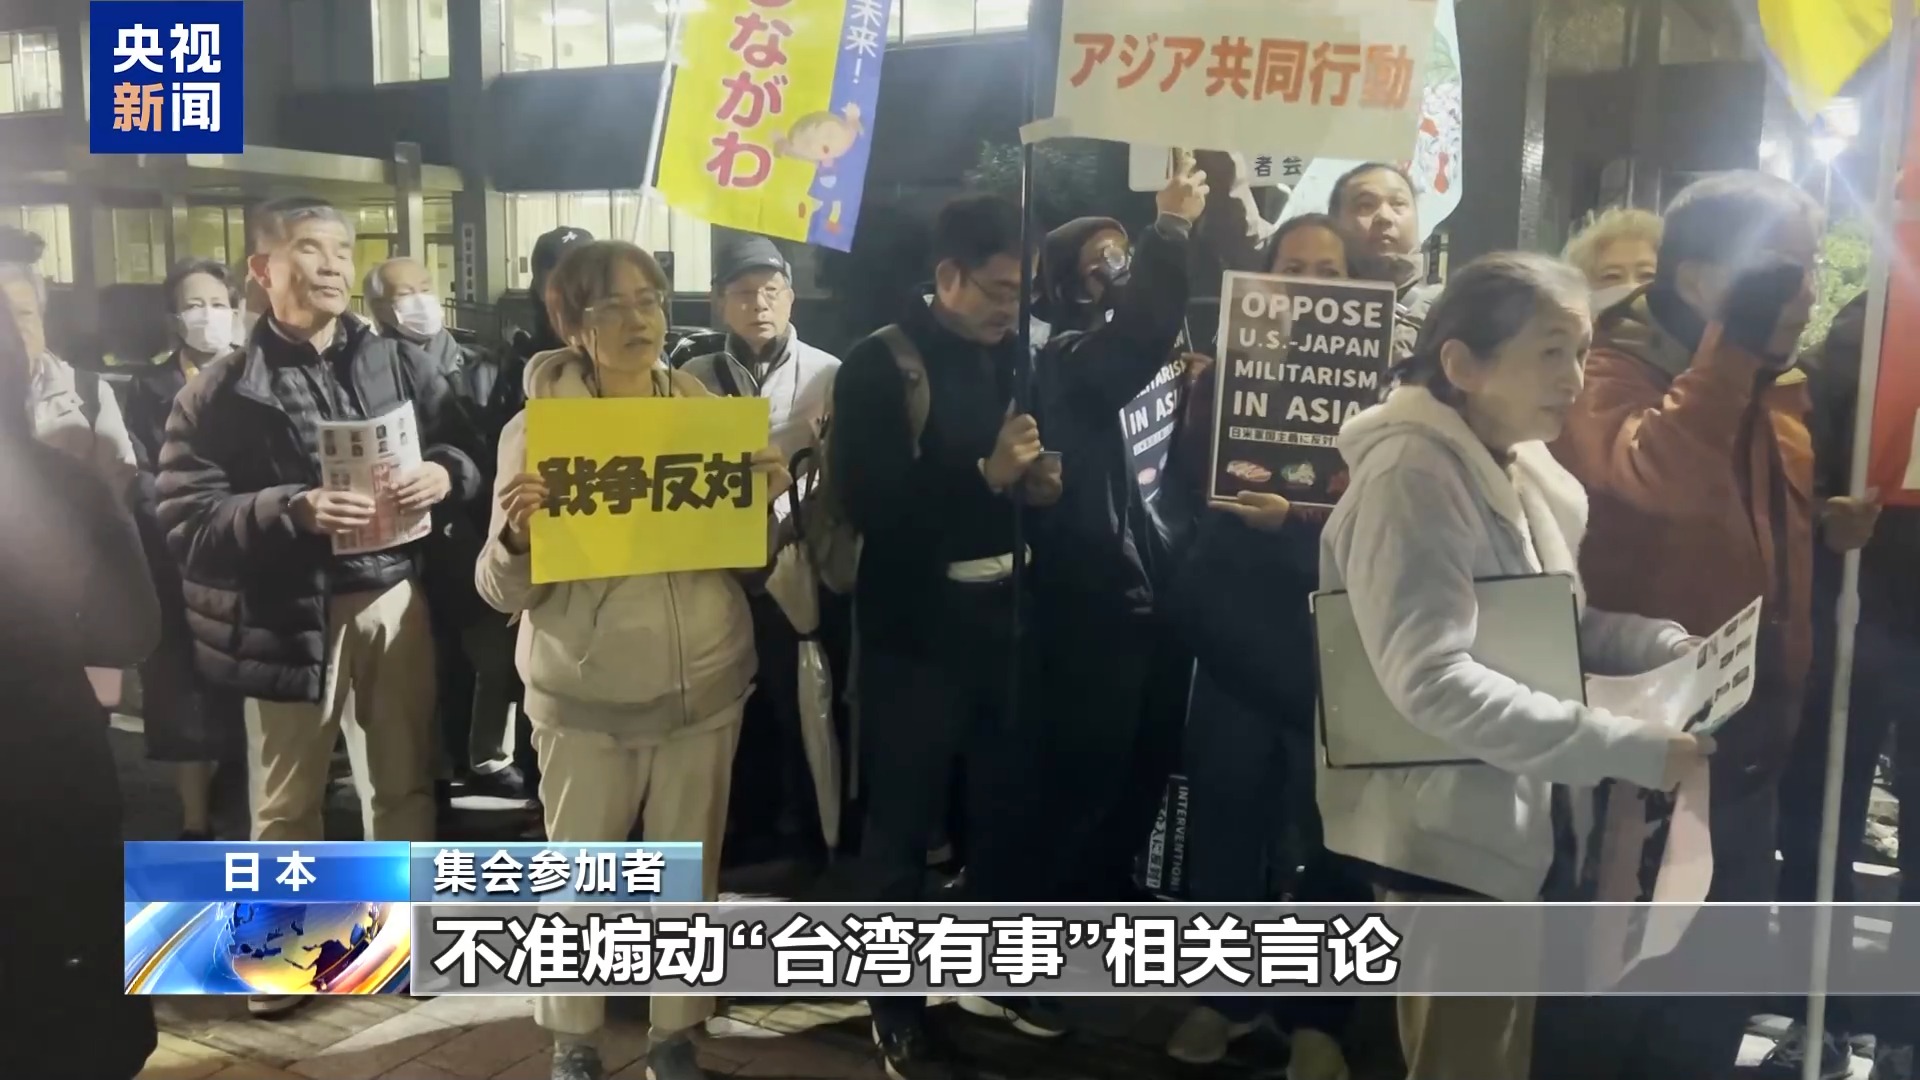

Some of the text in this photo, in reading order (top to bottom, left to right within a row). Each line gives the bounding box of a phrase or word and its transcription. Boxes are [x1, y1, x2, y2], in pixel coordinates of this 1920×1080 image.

[1070, 33, 1415, 109] アジア共同行動
[706, 0, 794, 188] ながわ
[1241, 291, 1384, 329] OPPOSE
[1239, 327, 1381, 358] U.S.-JAPAN
[1234, 358, 1378, 390] MILITARISM
[1129, 389, 1180, 436] IN ASI
[1233, 390, 1268, 418] IN
[538, 452, 752, 517] 戦争反対
